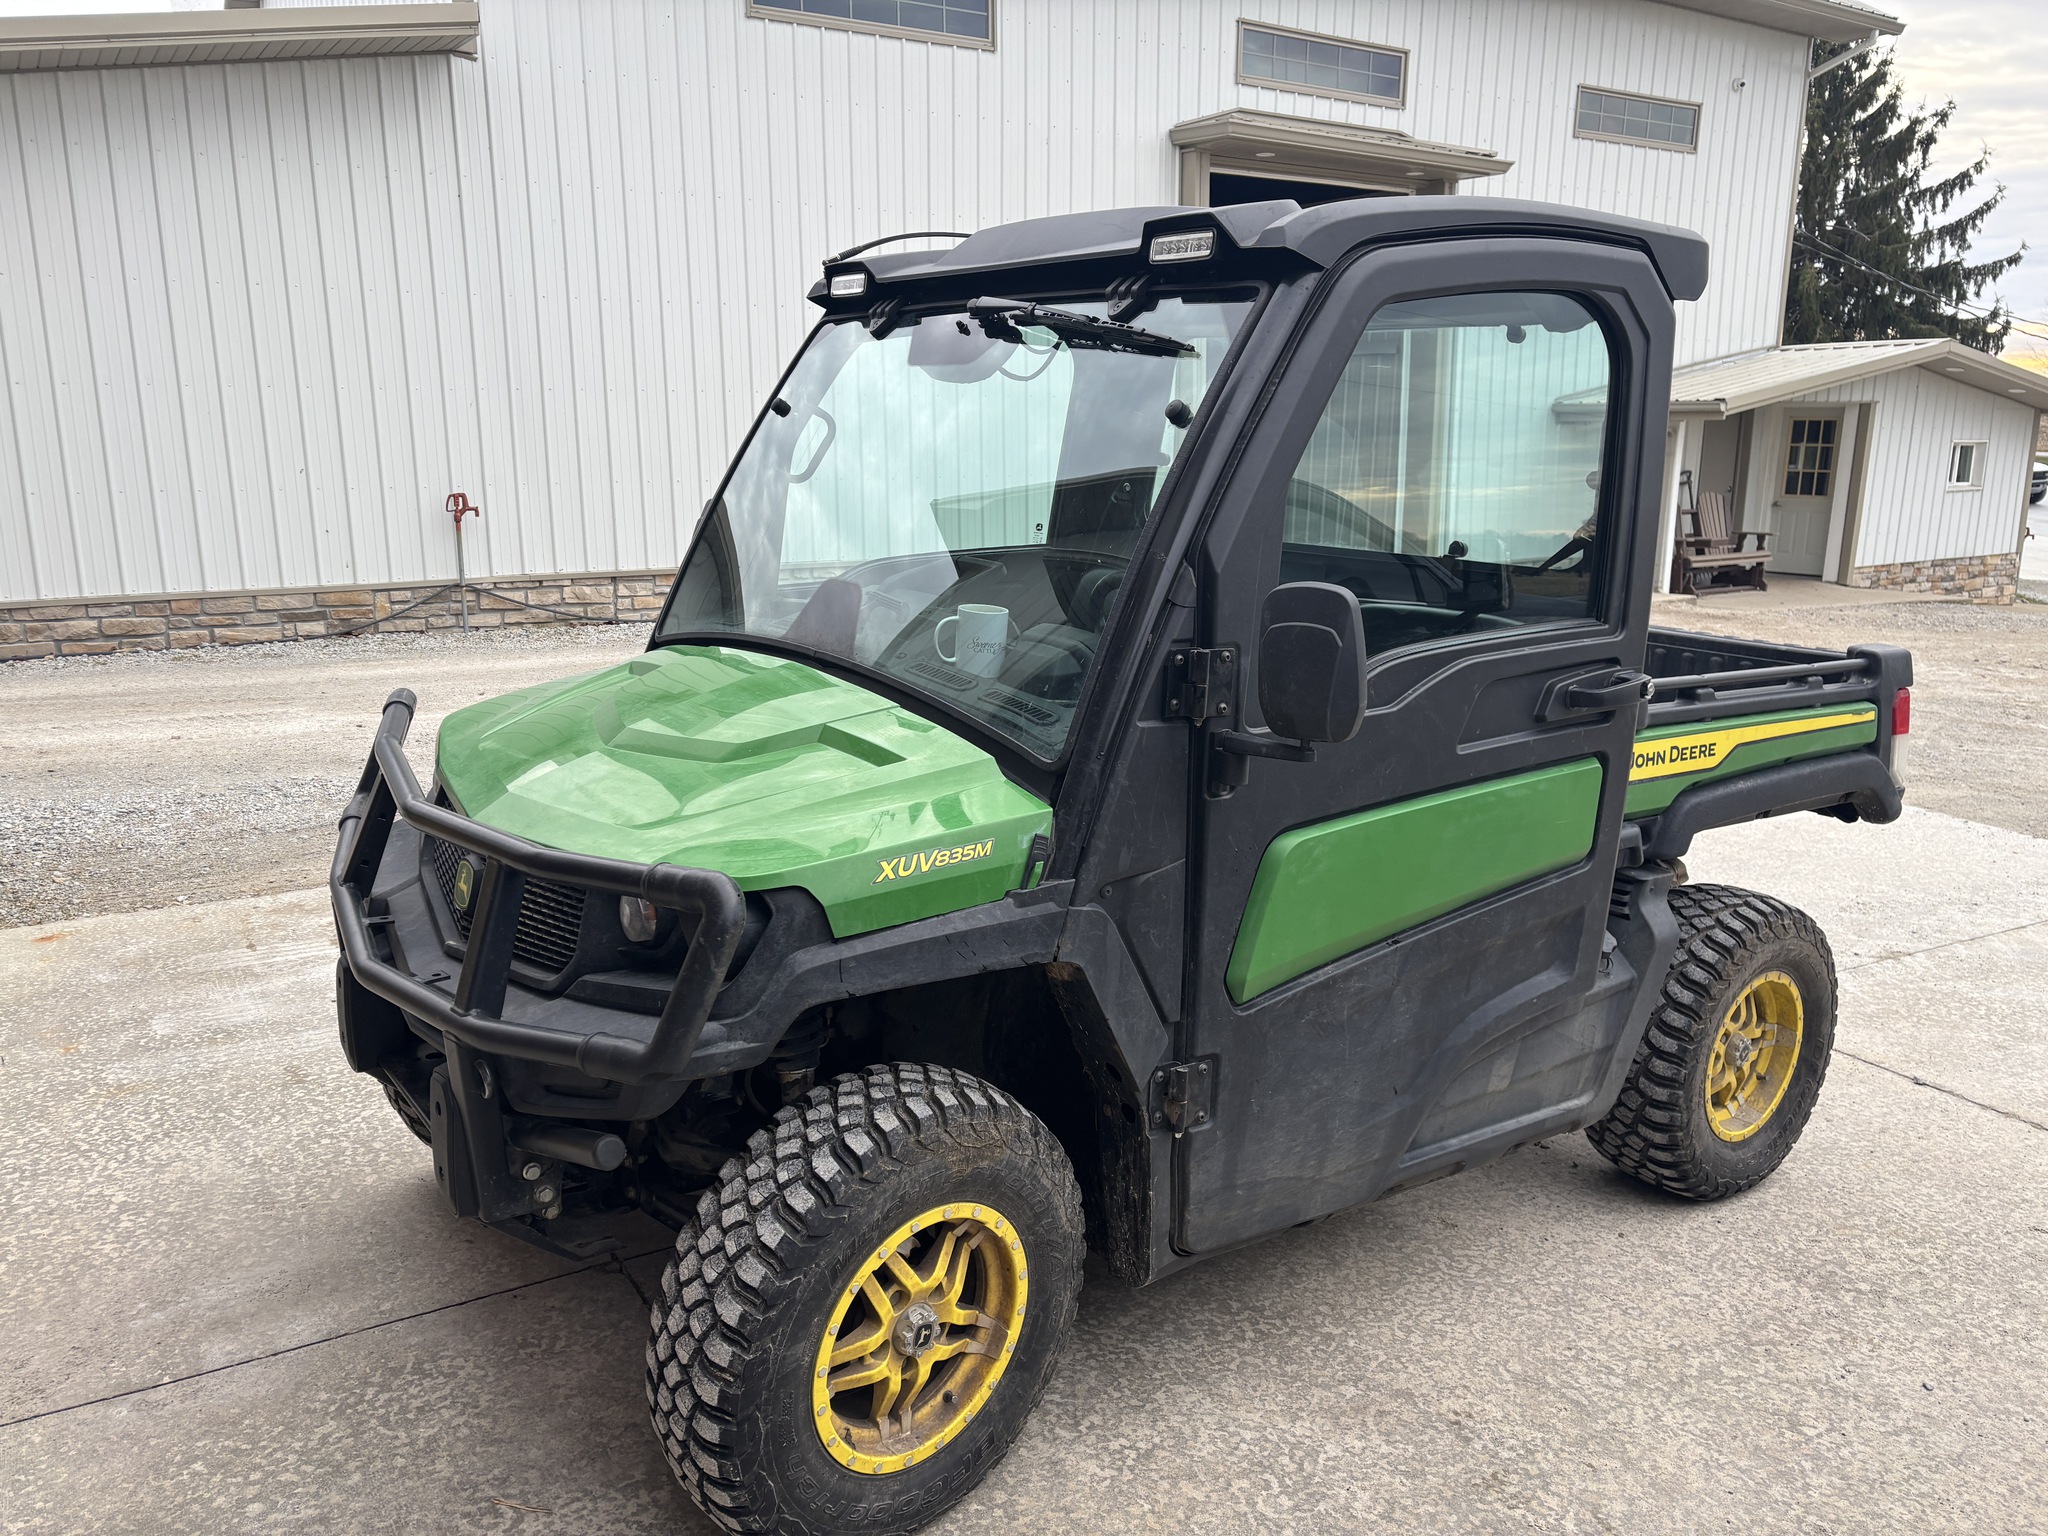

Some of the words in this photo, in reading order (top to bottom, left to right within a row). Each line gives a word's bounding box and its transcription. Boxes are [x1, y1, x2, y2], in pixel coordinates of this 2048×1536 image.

[1630, 750, 1666, 769] JOHN
[1669, 743, 1717, 763] DEERE
[871, 839, 994, 885] XUV835M
[784, 1427, 996, 1524] BFGoodrich
